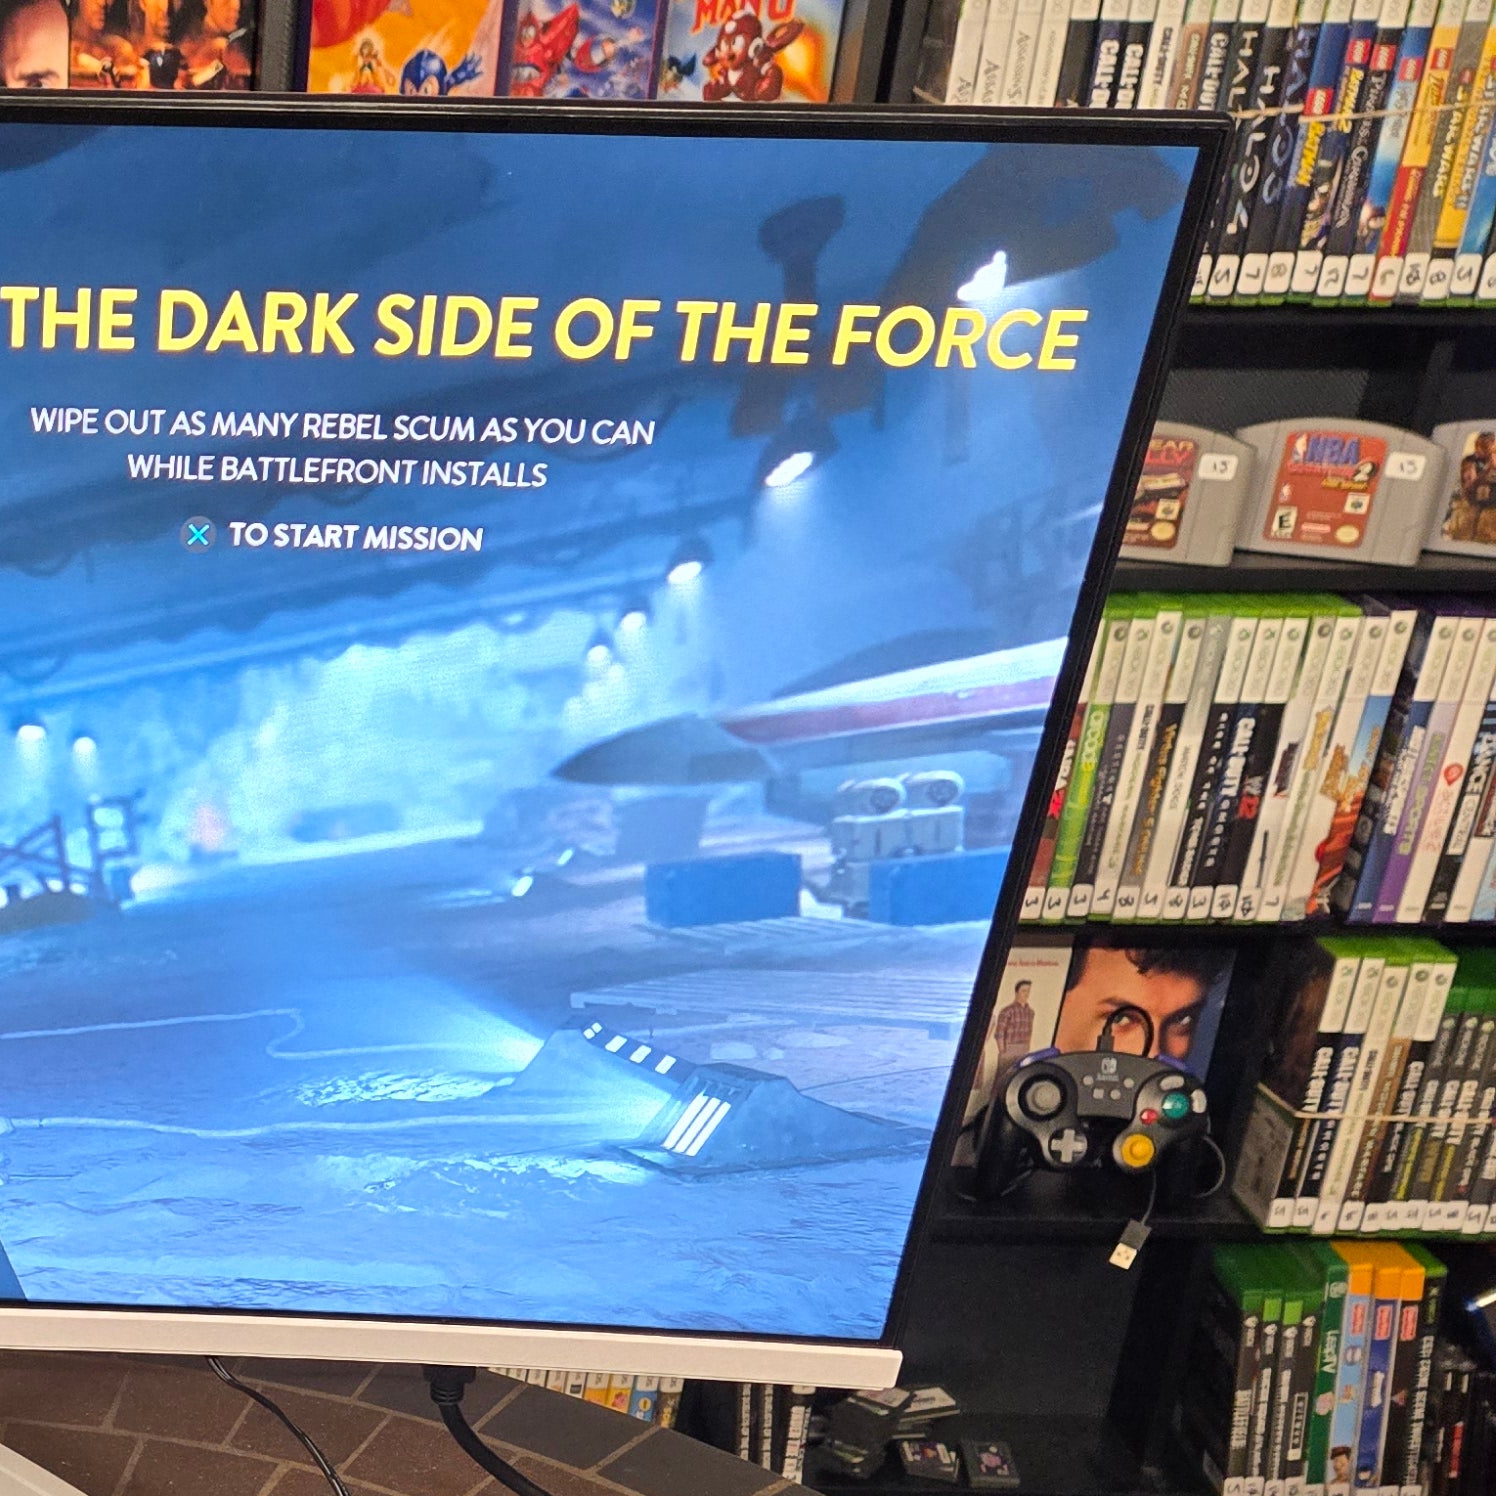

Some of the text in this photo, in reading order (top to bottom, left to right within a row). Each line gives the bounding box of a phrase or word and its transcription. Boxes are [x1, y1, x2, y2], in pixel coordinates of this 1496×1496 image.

[1093, 40, 1119, 84] CALL
[1119, 45, 1143, 85] CALL
[1198, 34, 1228, 110] CALL DUT
[1234, 68, 1282, 189] HALO
[1294, 123, 1324, 184] BATMAN
[0, 287, 137, 349] THE
[159, 290, 357, 353] DARK
[375, 294, 538, 357] SIDE
[555, 298, 660, 359] OF
[677, 302, 818, 363] THE
[832, 305, 1087, 370] FORCE
[31, 408, 655, 444] WIPE OUT AS MANY REBEL SCUM AS YOU CAN
[1149, 438, 1194, 451] EAR
[1307, 434, 1361, 466] NBA
[128, 455, 547, 487] WHILE BATTLEFRONT INSTALLS
[1354, 460, 1377, 482] 2
[230, 522, 483, 551] TO START MISSION
[1231, 718, 1254, 753] CALL
